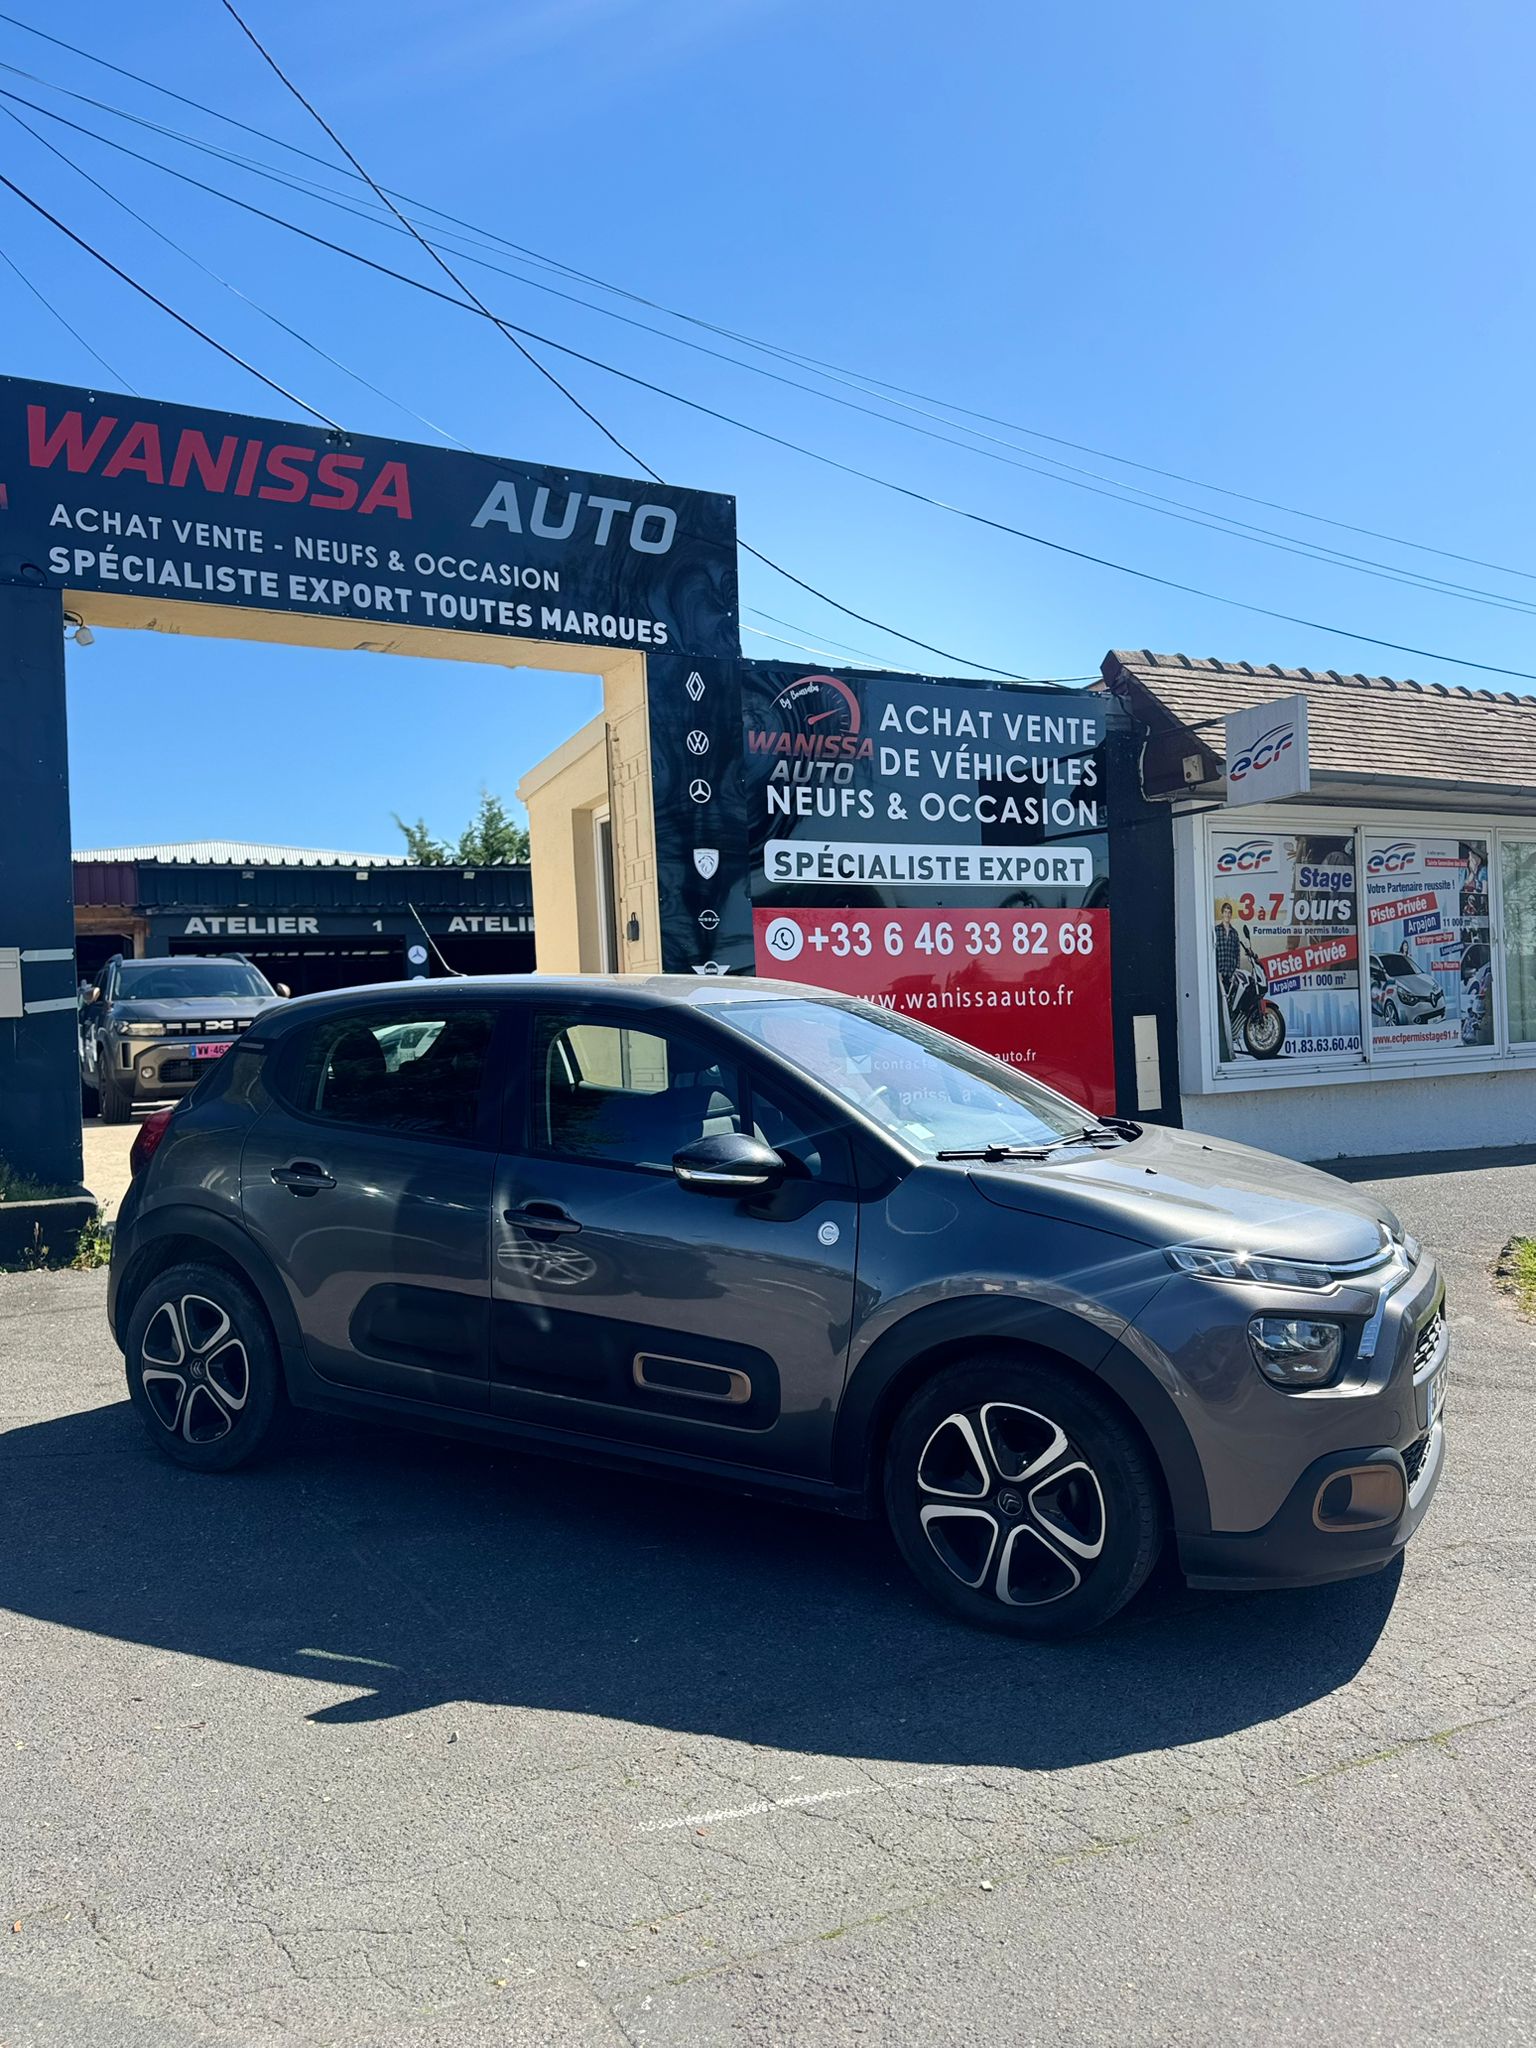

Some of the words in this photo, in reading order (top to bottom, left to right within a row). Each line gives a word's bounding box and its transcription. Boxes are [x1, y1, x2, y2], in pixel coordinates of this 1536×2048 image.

[26, 404, 413, 520] WANISSA
[470, 480, 678, 555] AUTO
[49, 503, 162, 540] ACHAT
[172, 520, 263, 554] VENTE
[295, 536, 378, 569] NEUFS
[388, 550, 405, 573] &
[414, 552, 560, 593] OCCASION
[49, 544, 279, 598] SPÉCIALISTE
[289, 574, 412, 613] EXPORT
[421, 590, 532, 628] TOUTES
[541, 608, 668, 645] MARQUES
[879, 703, 992, 739] ACHAT
[1003, 712, 1096, 746] VENTE
[748, 730, 874, 760] WANISSA
[769, 760, 855, 785] AUTO
[880, 747, 920, 777] DE
[931, 743, 1098, 786] VÉHICULES
[766, 785, 875, 818] NEUFS
[887, 792, 909, 820] &
[920, 792, 1097, 826] OCCASION
[774, 845, 970, 881] SPÉCIALISTE
[979, 857, 1085, 881] EXPORT
[1299, 866, 1353, 891] Stage
[1367, 883, 1386, 894] Votre
[1387, 881, 1423, 893] Partenaire
[1238, 893, 1255, 921] 3
[1257, 906, 1266, 921] à
[1269, 893, 1285, 921] 7
[1370, 906, 1395, 924] Piste
[1397, 897, 1427, 915] Privée
[184, 917, 319, 934] ATELIER
[372, 920, 383, 932] 1
[808, 922, 872, 957] +33
[884, 922, 904, 956] 6
[914, 922, 954, 955] 46
[964, 921, 1001, 955] 33
[1012, 922, 1049, 955] 82
[1058, 923, 1094, 955] 68
[1253, 926, 1291, 935] Formation
[1305, 927, 1330, 937] permis
[1331, 926, 1349, 935] Moto
[1408, 916, 1437, 934] Arpajon
[1267, 954, 1303, 978] Piste
[1305, 942, 1347, 968] Privée
[1273, 979, 1297, 993] Arpajon
[1302, 974, 1313, 987] 11
[1316, 974, 1333, 986] 000
[1285, 1037, 1360, 1054] 01.83.63.60.40
